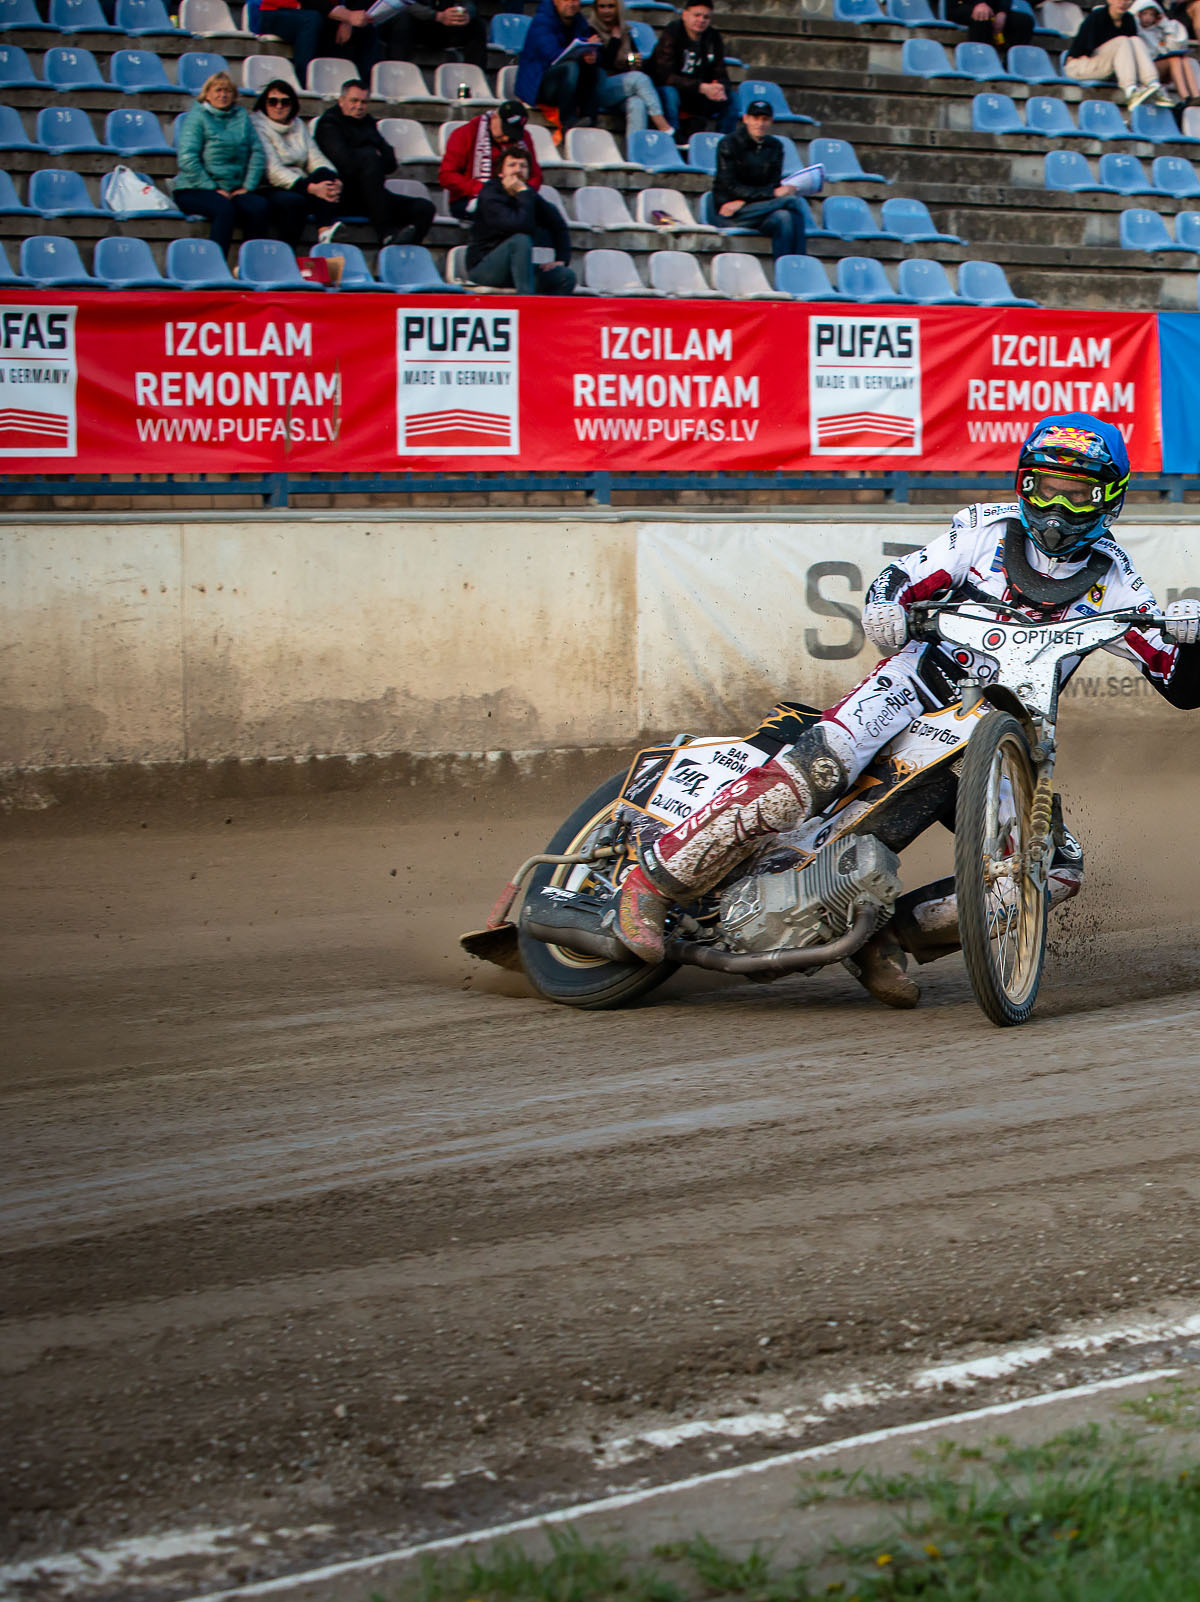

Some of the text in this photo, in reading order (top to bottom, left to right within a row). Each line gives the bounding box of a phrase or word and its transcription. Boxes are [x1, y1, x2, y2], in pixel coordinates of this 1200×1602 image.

[0, 312, 68, 349] FAS
[165, 322, 312, 356] IZCILAM
[404, 316, 510, 351] PUFAS
[601, 327, 732, 361] IZCILAM
[816, 324, 912, 358] PUFAS
[992, 334, 1111, 368] IZCILAM
[135, 372, 341, 406] REMONTAM
[404, 370, 511, 385] MADE IN GERMANY
[573, 374, 760, 408] REMONTAM
[816, 375, 845, 389] MADE
[864, 376, 914, 390] GERMANY
[967, 379, 1135, 412] REMONTAM
[136, 418, 342, 442] WWW.PUFAS.LV
[574, 418, 760, 441] WWW.PUFAS.LV
[1012, 630, 1084, 646] OPTIBET
[727, 747, 749, 763] BAR
